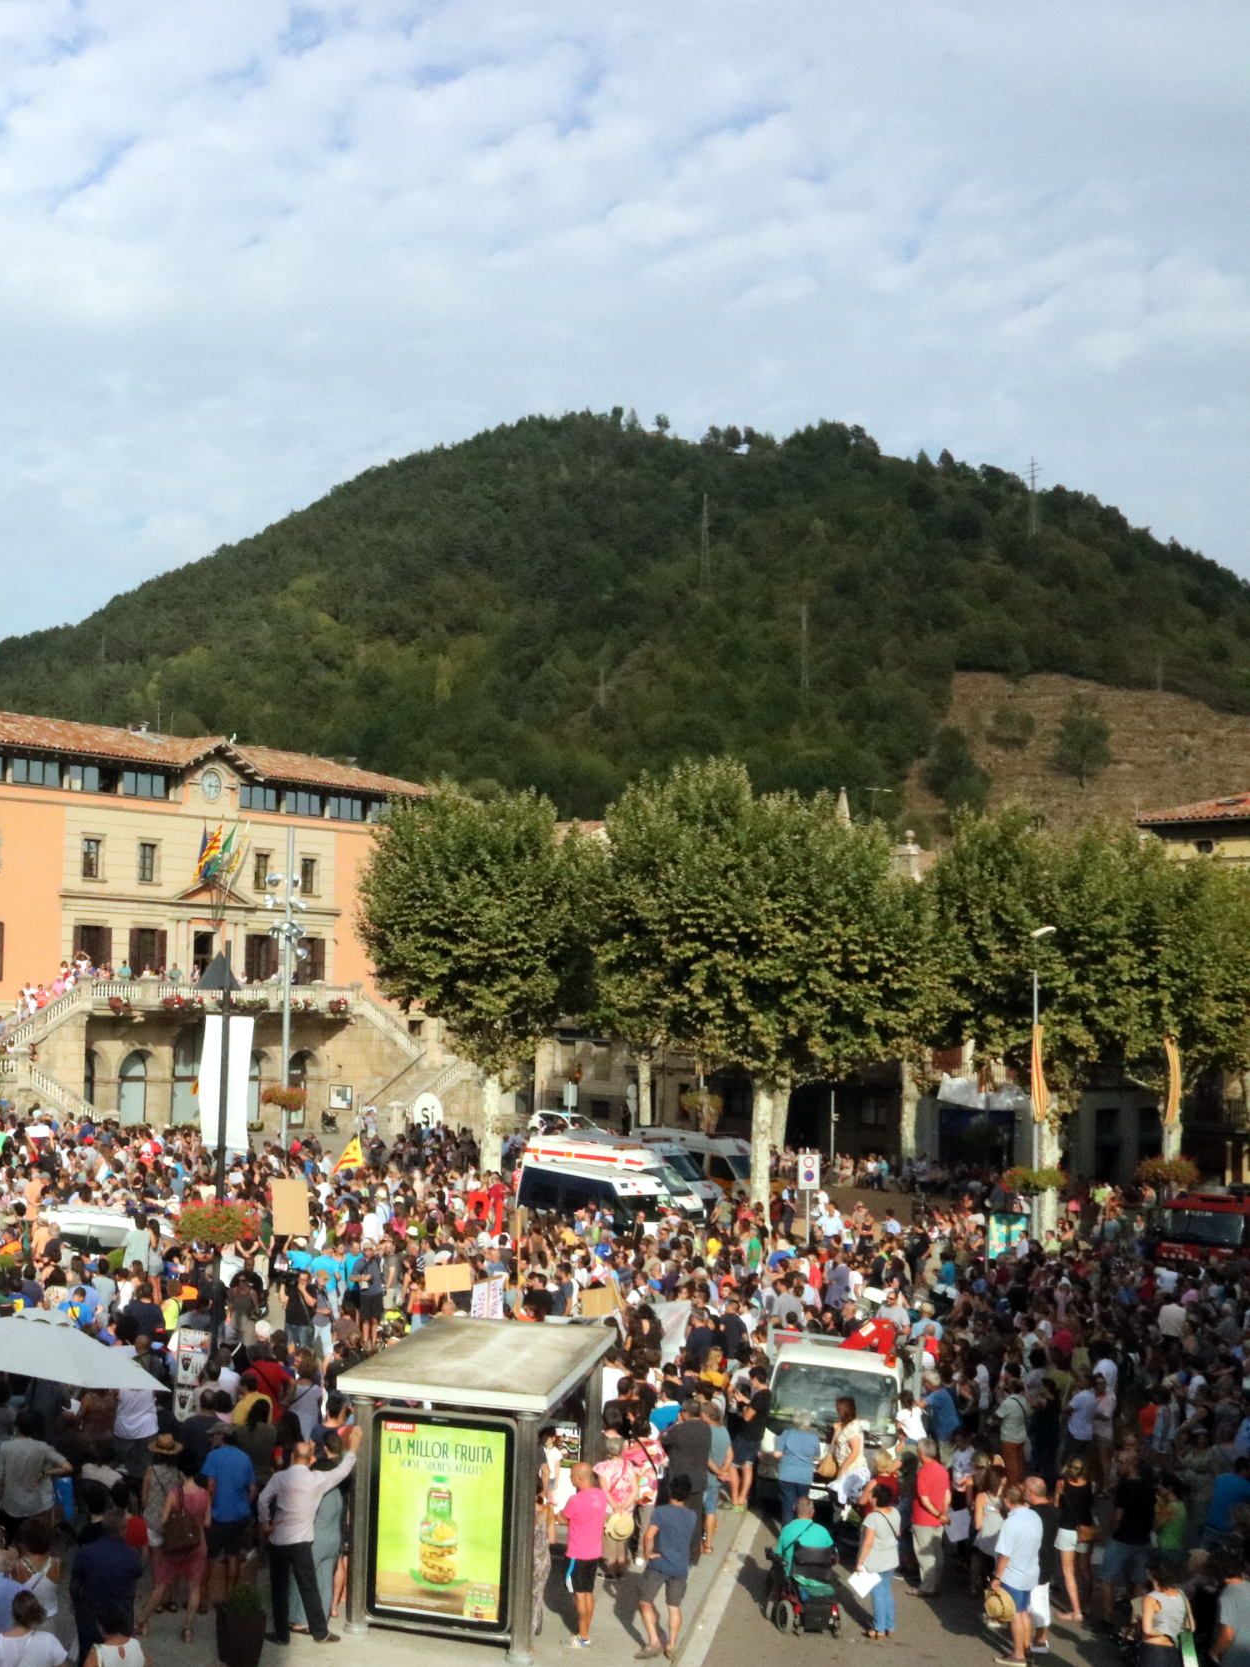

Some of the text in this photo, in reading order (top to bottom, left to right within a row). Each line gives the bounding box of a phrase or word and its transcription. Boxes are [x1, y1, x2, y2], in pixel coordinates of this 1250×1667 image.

[421, 1105, 435, 1125] Sí
[386, 1422, 413, 1431] granini
[388, 1437, 493, 1464] LA MILLOR FRUITA
